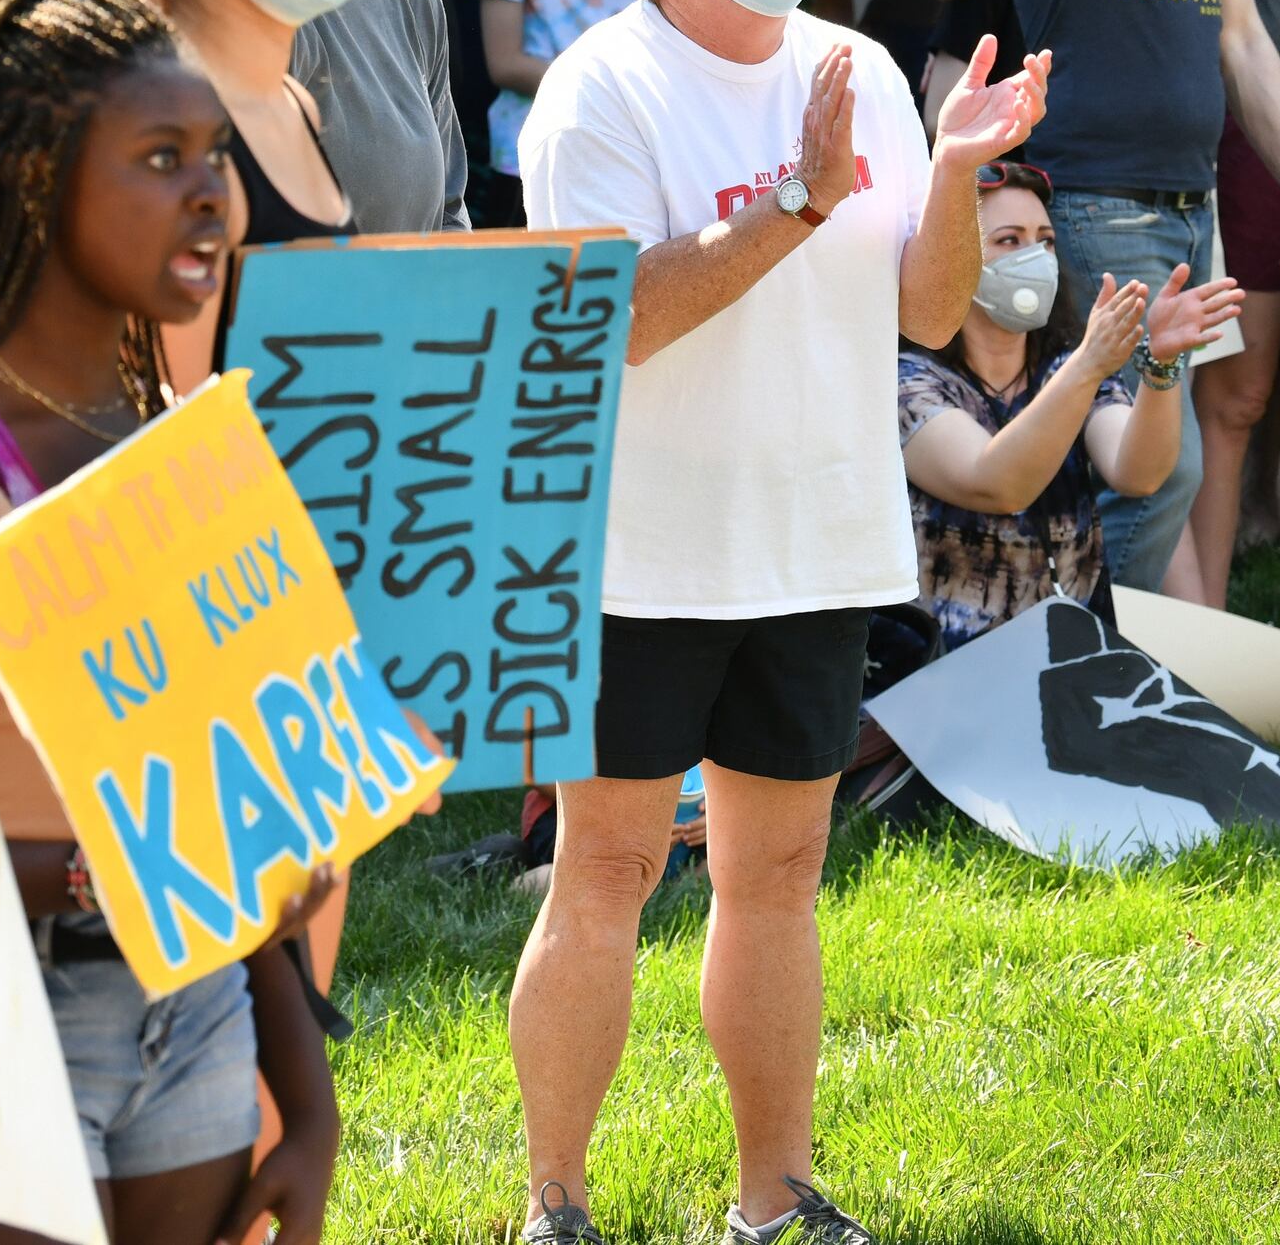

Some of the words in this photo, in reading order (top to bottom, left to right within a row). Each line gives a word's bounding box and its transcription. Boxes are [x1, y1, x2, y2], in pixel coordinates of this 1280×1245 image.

[381, 307, 497, 598] SMALL
[501, 261, 619, 504] ENERGY
[80, 618, 169, 721] KU
[187, 526, 303, 648] KLUX
[389, 651, 466, 761] IS
[484, 538, 581, 744] DICK
[94, 637, 443, 969] KAREN
